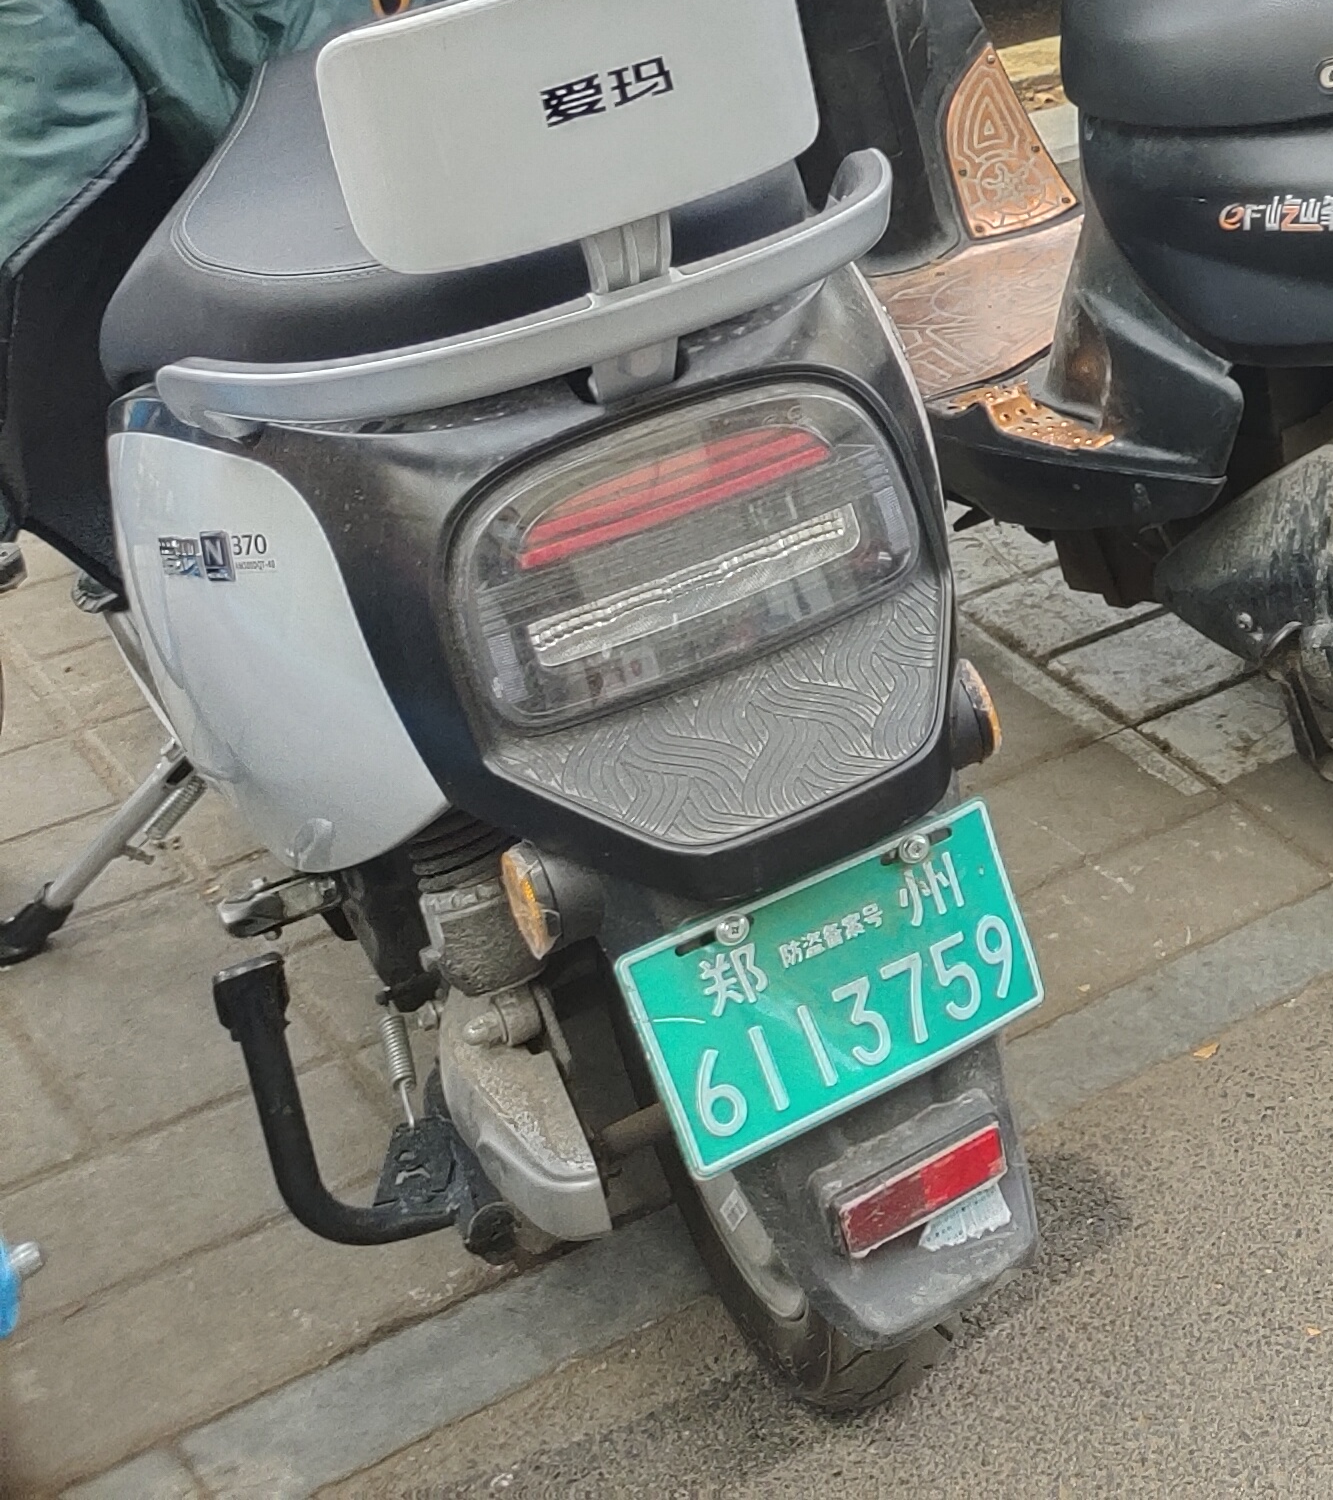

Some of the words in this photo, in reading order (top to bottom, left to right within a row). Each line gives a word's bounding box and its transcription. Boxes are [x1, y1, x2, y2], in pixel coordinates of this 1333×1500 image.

[539, 55, 674, 128] 爱玛
[231, 534, 268, 556] 370
[699, 943, 769, 1018] 郑
[778, 902, 885, 970] 防盗备案号
[899, 851, 965, 927] 州
[698, 914, 1014, 1138] 6113759
